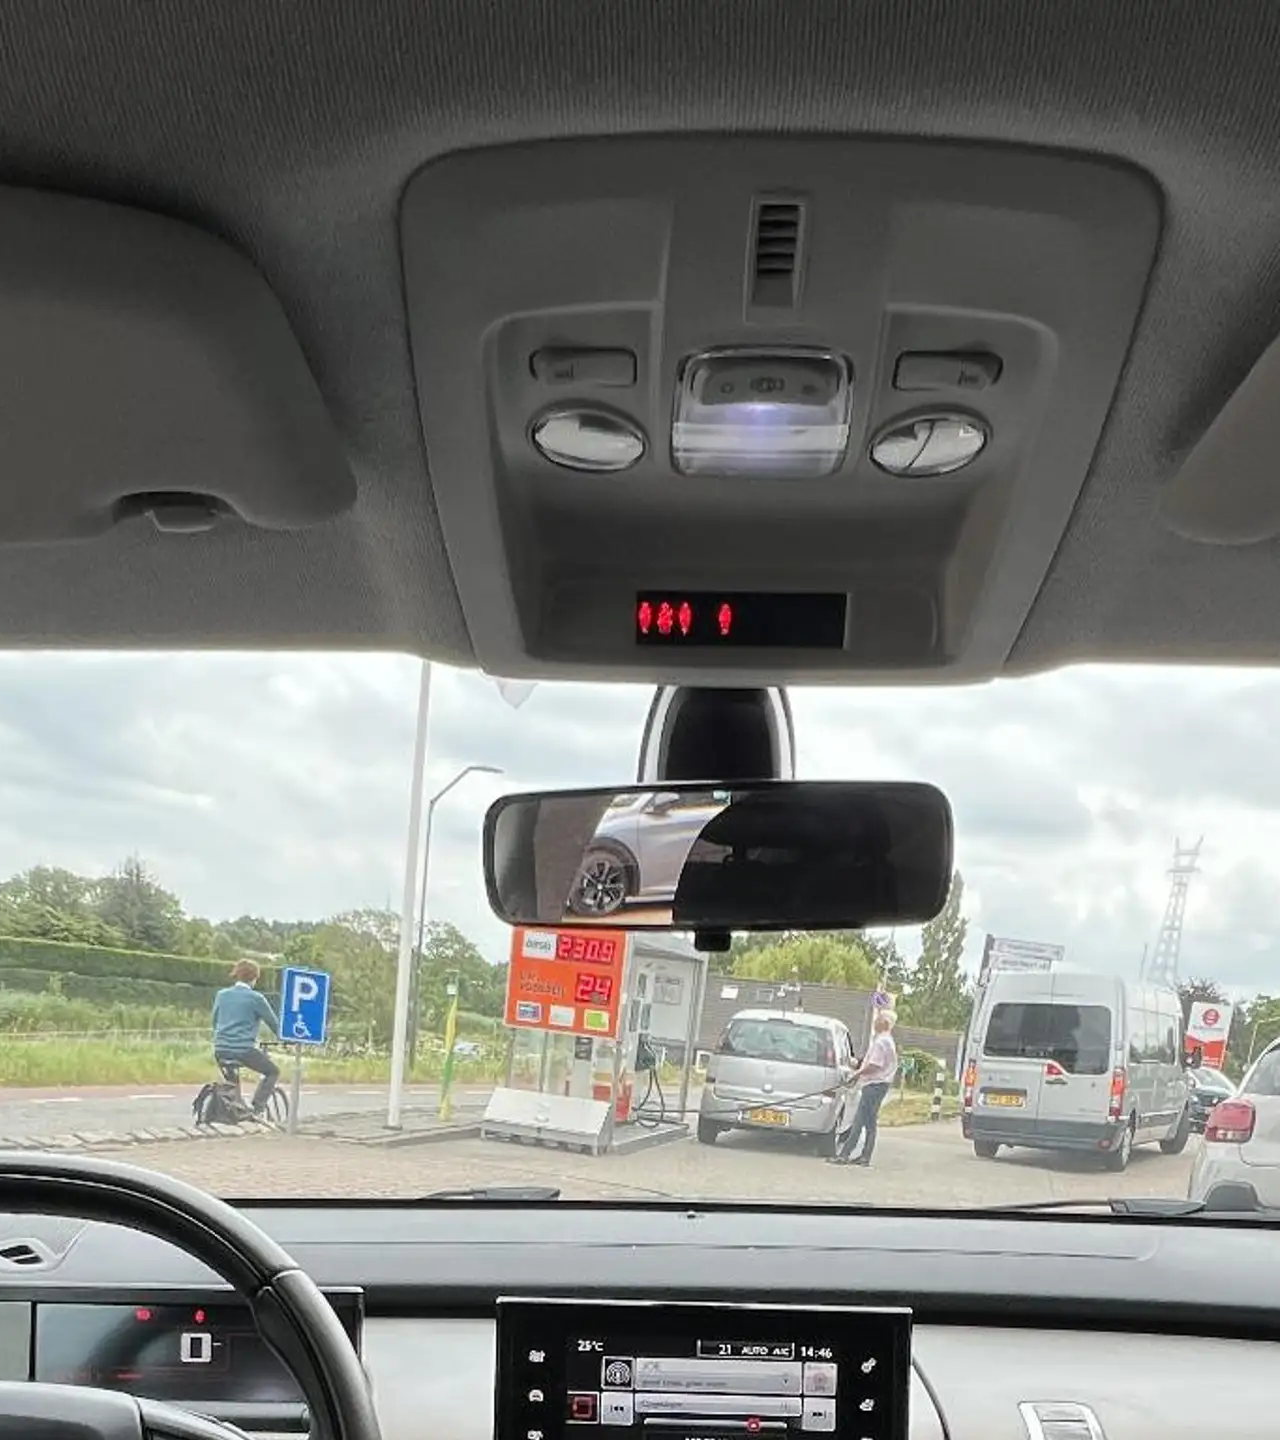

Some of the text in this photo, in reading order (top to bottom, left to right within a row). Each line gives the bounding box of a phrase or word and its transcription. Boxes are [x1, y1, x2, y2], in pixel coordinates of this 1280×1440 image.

[292, 976, 319, 1012] P
[741, 1346, 768, 1355] AUTO
[800, 1346, 833, 1359] 14:46
